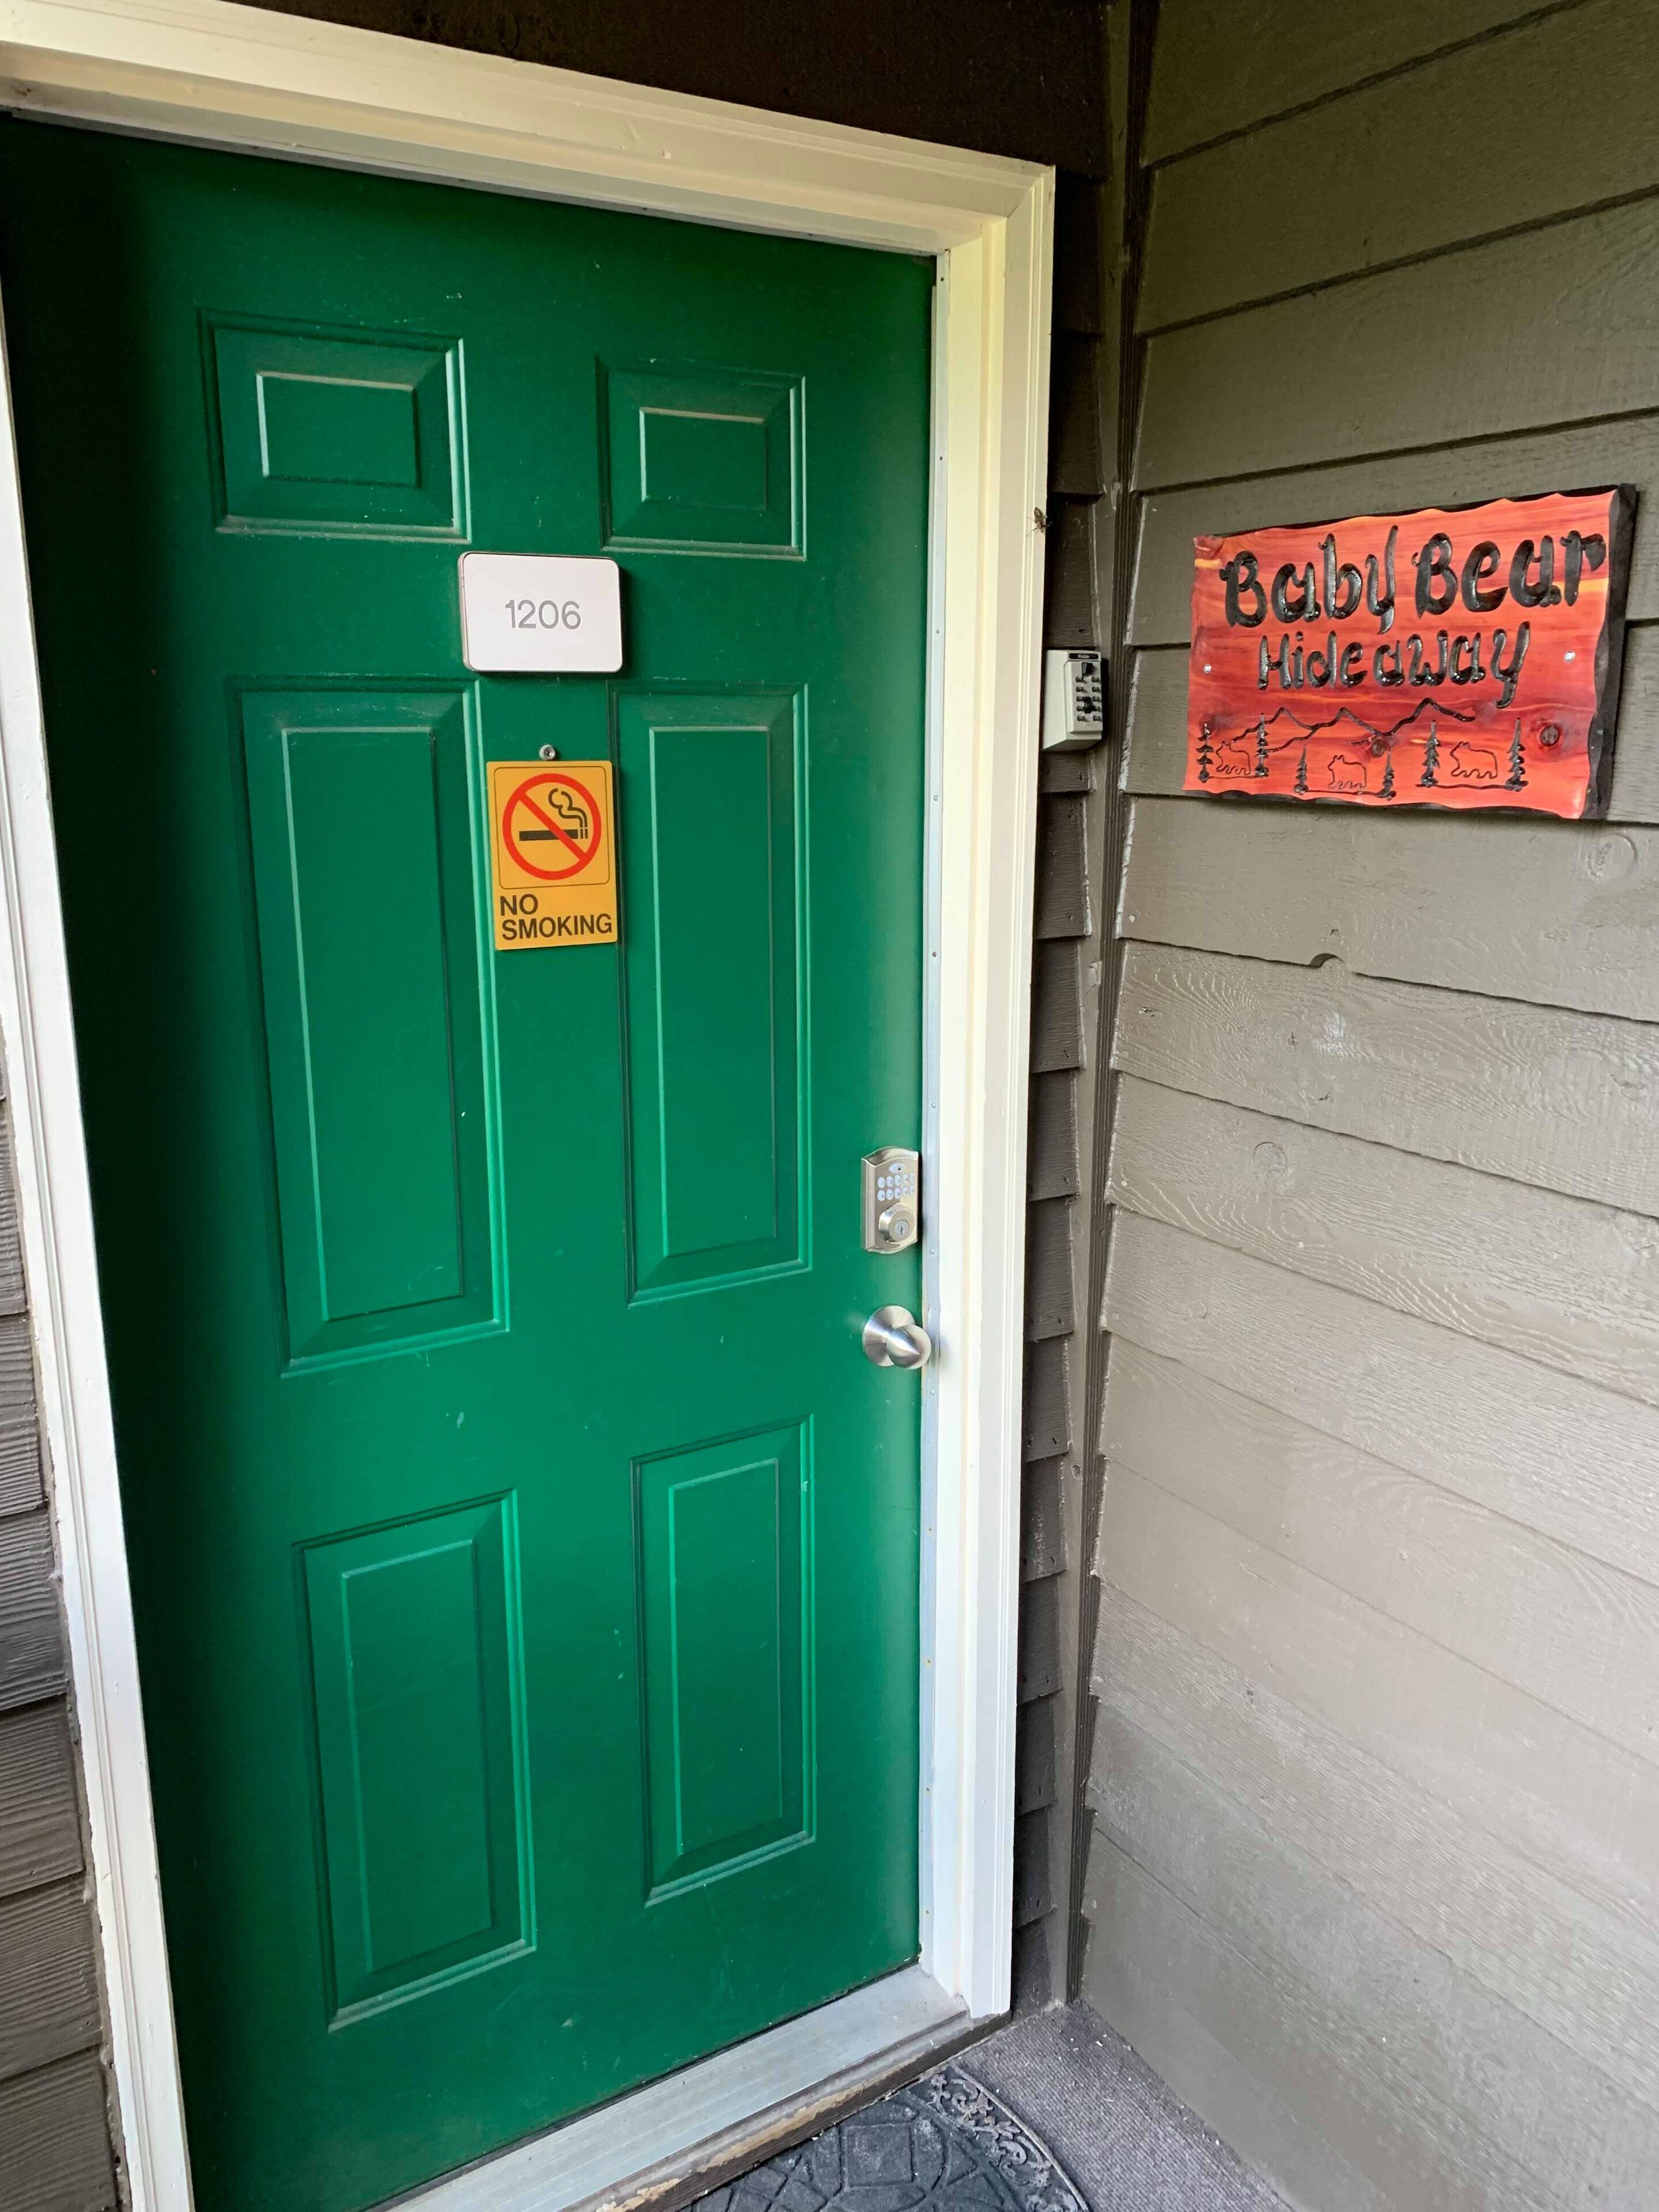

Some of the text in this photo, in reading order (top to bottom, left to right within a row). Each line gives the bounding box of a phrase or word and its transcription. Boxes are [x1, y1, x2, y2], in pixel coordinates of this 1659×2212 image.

[1219, 525, 1607, 634] Baby Bear
[505, 599, 581, 630] 1206
[1257, 621, 1531, 709] Hideaway
[500, 893, 539, 916] NO
[502, 913, 612, 941] SMOKING
